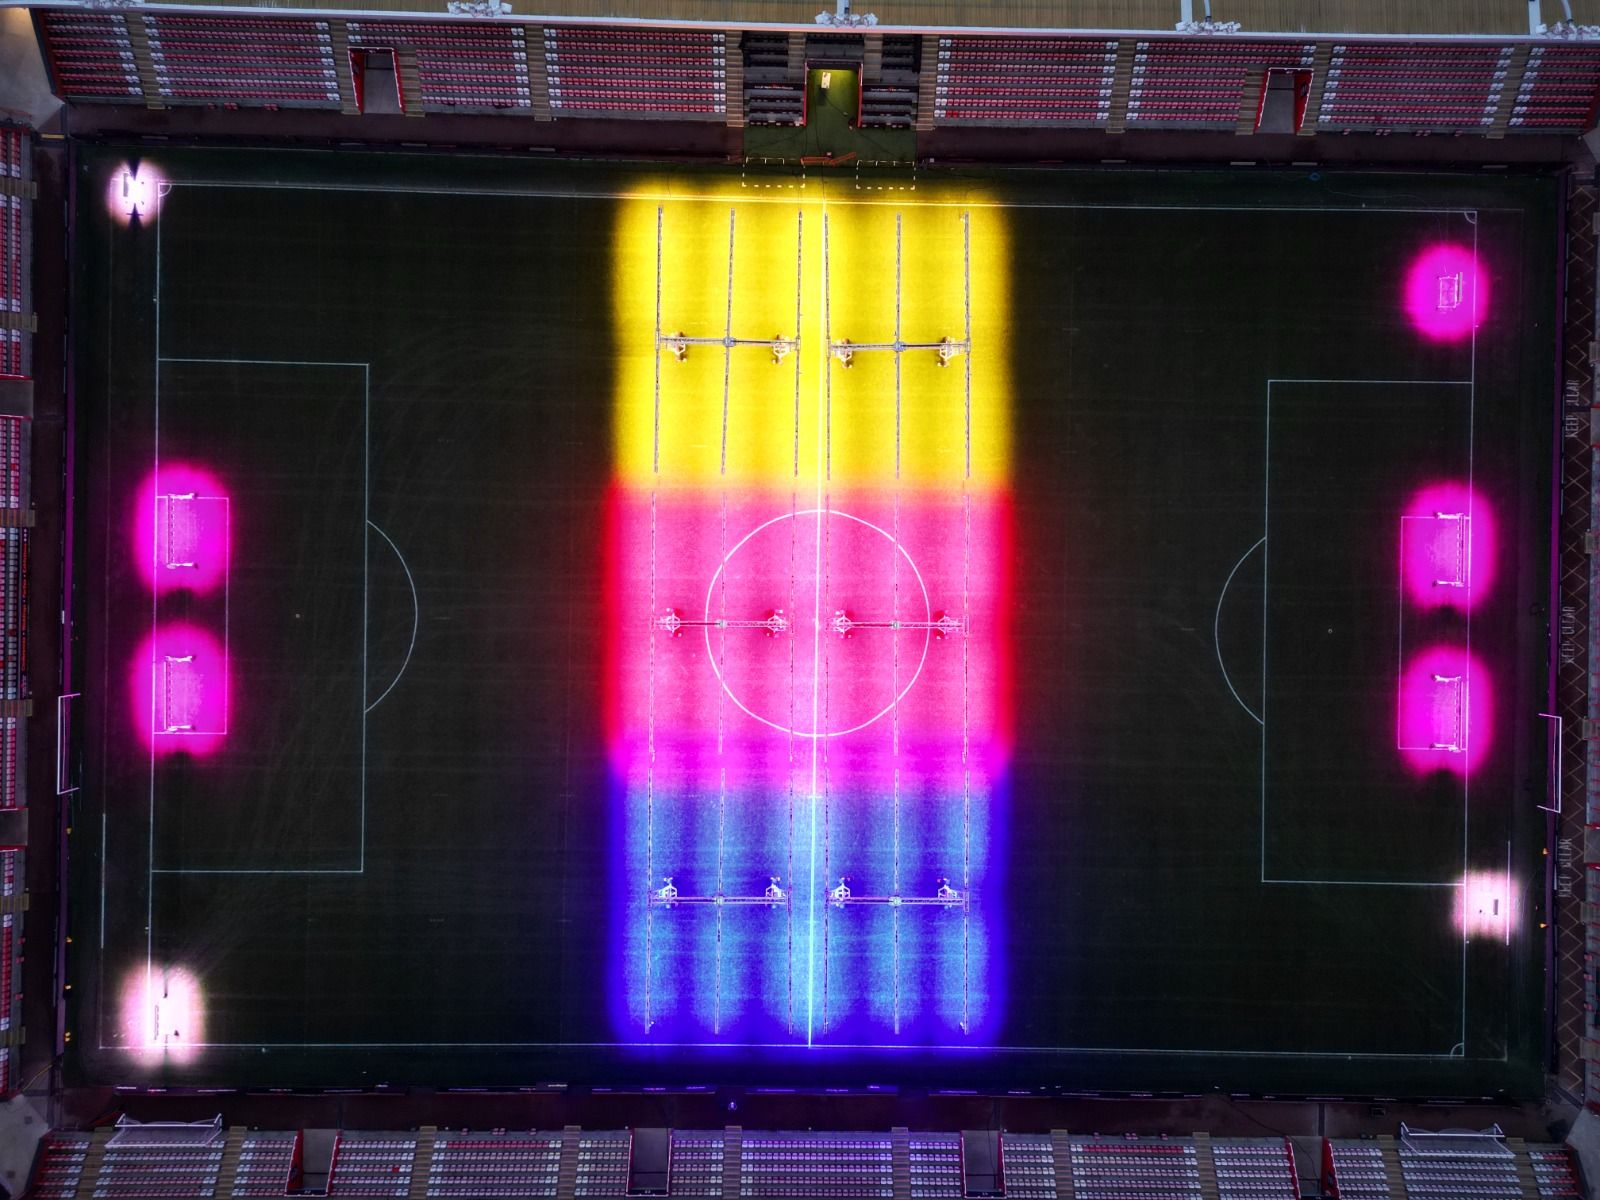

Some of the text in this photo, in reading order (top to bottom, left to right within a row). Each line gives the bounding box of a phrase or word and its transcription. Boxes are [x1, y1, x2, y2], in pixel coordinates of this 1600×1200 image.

[1564, 415, 1579, 438] KEEP
[1560, 606, 1576, 664] KEEP CLEAR
[1557, 838, 1573, 898] KEEP CLEAR
